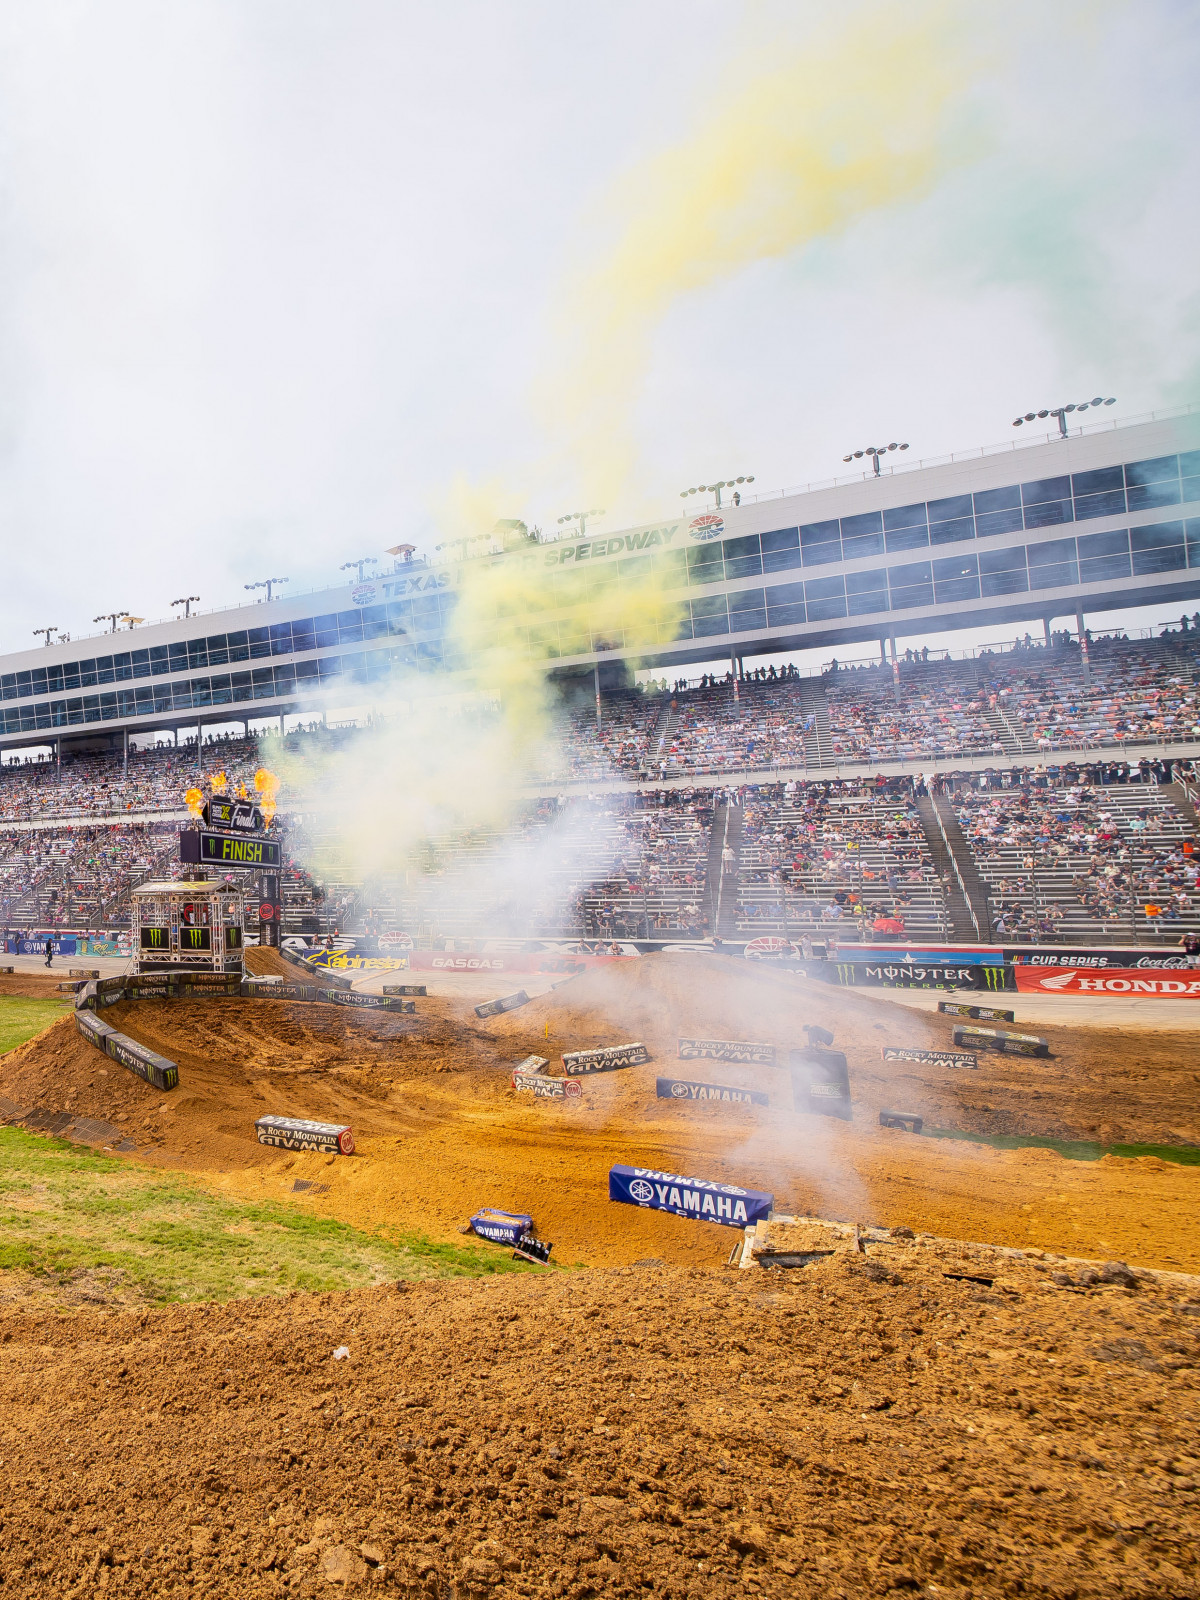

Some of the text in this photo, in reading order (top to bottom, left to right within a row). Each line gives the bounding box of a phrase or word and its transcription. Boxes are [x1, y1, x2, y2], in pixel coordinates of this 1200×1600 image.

[382, 571, 449, 598] TEXAS
[543, 525, 678, 567] SPEEDWAY
[231, 804, 255, 828] Finals
[222, 839, 262, 862] FINISH
[431, 958, 504, 969] GASGAS
[1031, 955, 1108, 966] CUP SERIES
[865, 965, 974, 981] MONSTER
[139, 986, 167, 995] MONSTER
[259, 984, 297, 994] MONSTER
[1078, 978, 1200, 994] HONDA
[338, 994, 379, 1005] MONSTER
[694, 1041, 773, 1054] ROCKY MOUNTAIN
[899, 1050, 975, 1061] ROCKY MOUNTAIN
[116, 1046, 146, 1072] MONSTER
[578, 1048, 645, 1064] ROCKY MOUNTAIN
[689, 1085, 752, 1104] YAMAHA
[268, 1126, 337, 1145] ROCKY MOUNTAIN
[654, 1183, 748, 1222] YAMAHA
[484, 1227, 514, 1239] YAMAHA
